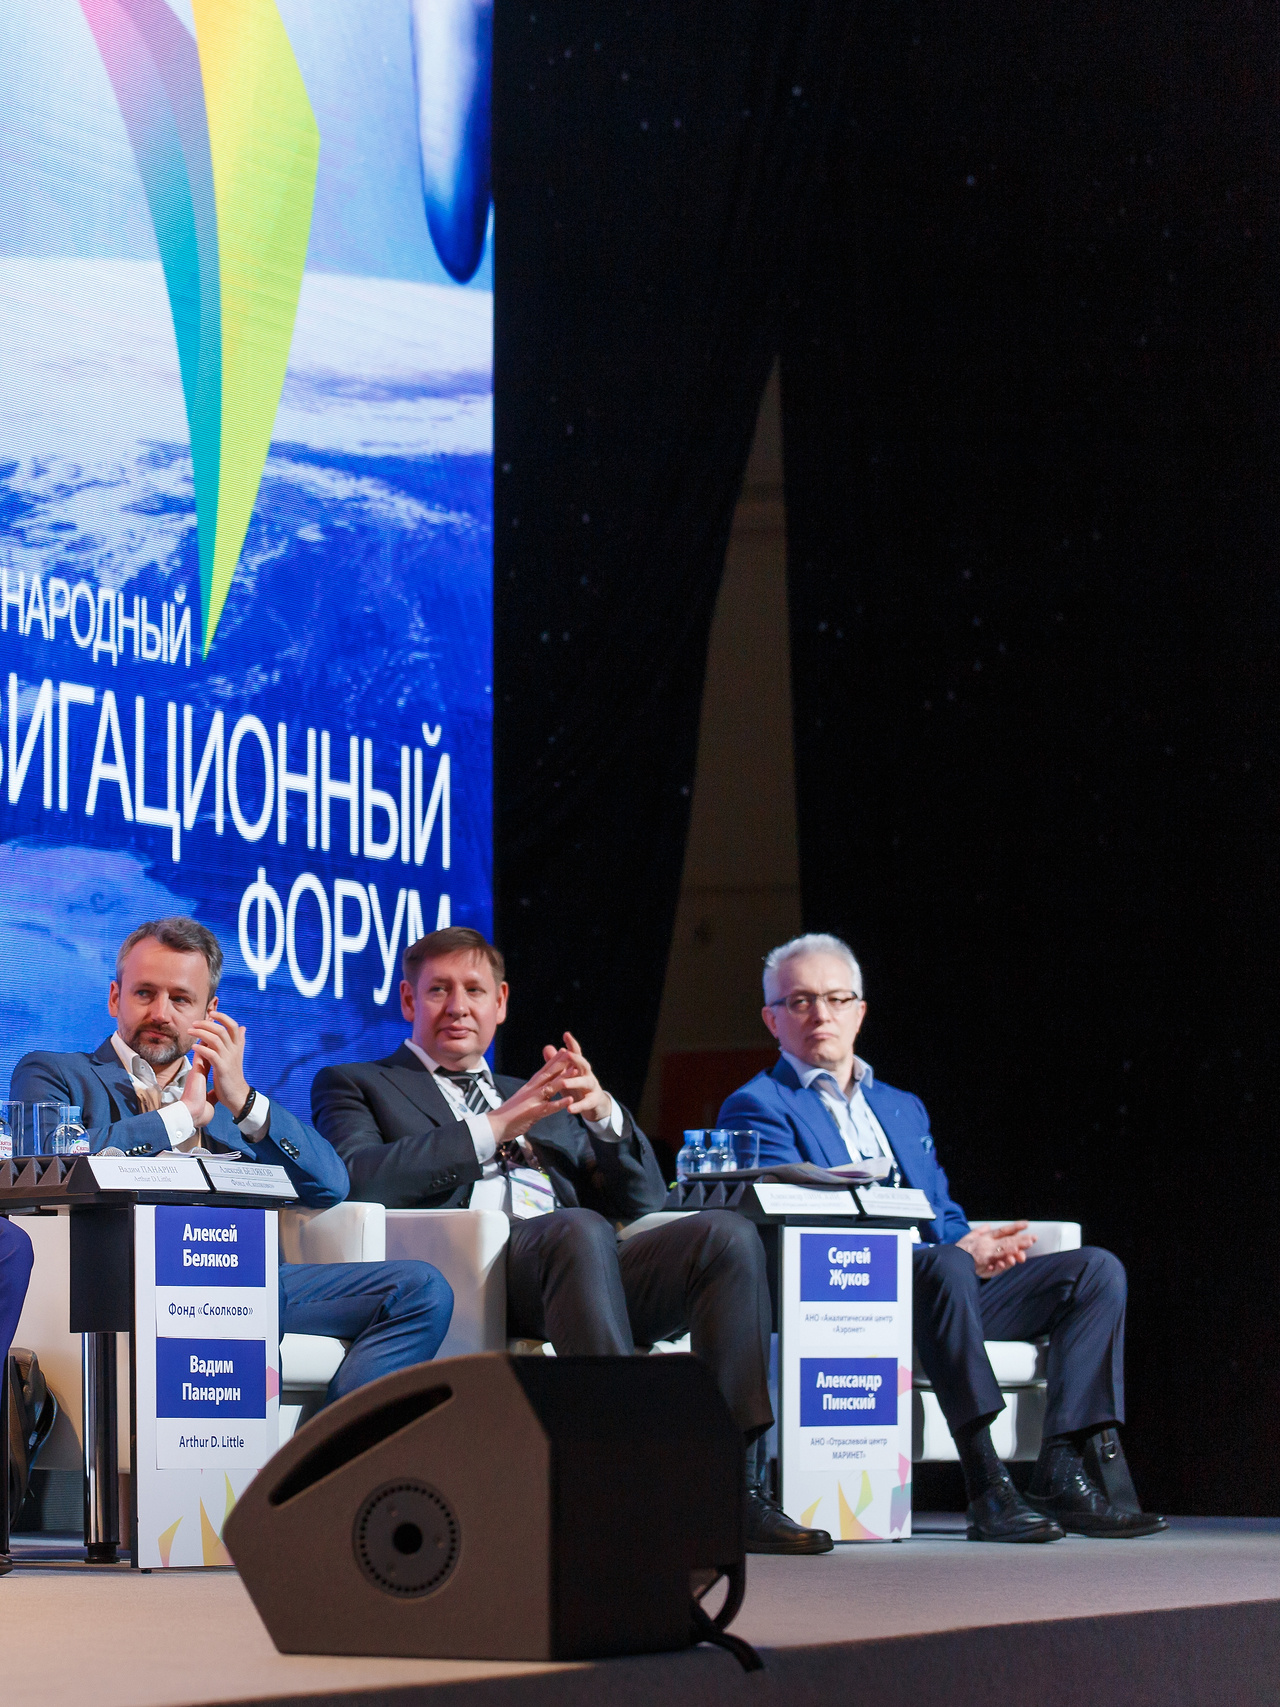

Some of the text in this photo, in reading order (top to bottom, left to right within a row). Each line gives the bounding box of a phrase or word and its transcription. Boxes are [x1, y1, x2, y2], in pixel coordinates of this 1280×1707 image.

[118, 1165, 178, 1174] Вадим ПАНАРИН
[183, 1223, 238, 1242] Алексей
[183, 1249, 239, 1268] Беляков
[828, 1246, 871, 1268] Сергей
[829, 1269, 870, 1290] Жуков
[168, 1302, 254, 1318] Фонд «Сколково»
[805, 1314, 819, 1322] АНО
[875, 1315, 893, 1323] центр
[190, 1355, 234, 1377] Вадим
[816, 1371, 882, 1392] Александр
[182, 1382, 241, 1405] Панарин
[822, 1392, 875, 1411] Пинский
[179, 1435, 245, 1448] Arthur D. Little
[810, 1437, 825, 1446] АНО
[869, 1438, 887, 1446] центр
